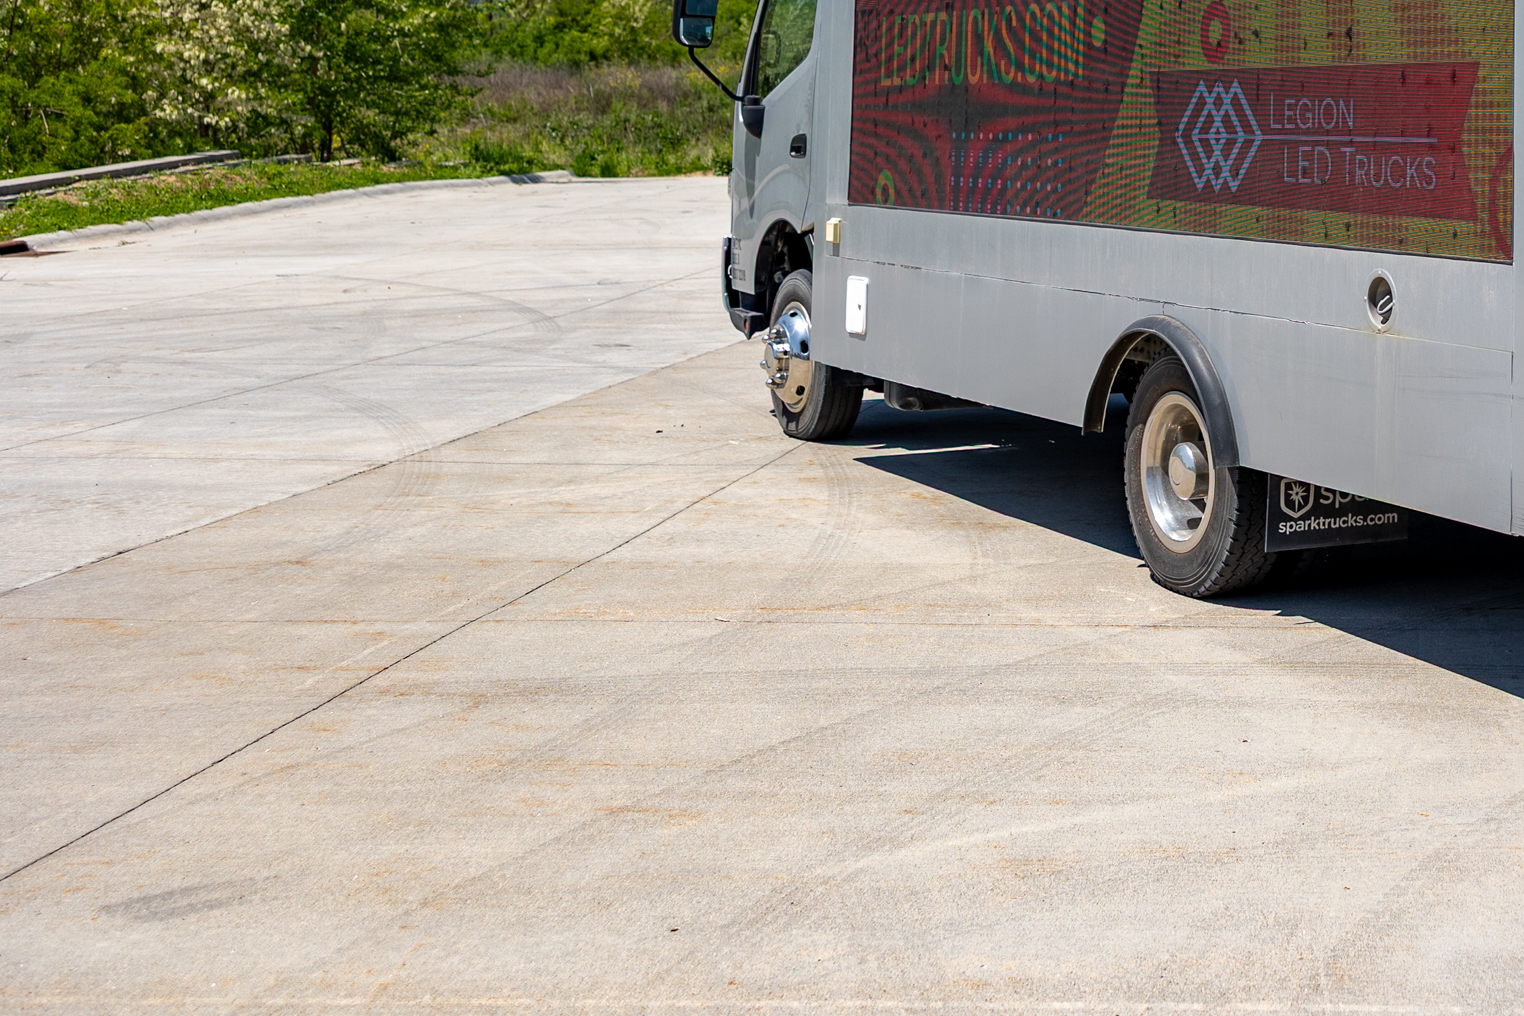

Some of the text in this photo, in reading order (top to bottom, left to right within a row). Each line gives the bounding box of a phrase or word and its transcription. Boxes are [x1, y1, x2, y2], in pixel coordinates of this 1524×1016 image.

[880, 0, 1085, 86] LEDTRUCKS.COM
[1269, 92, 1355, 130] LEGION
[1283, 146, 1437, 190] LED TRUCKS
[1278, 512, 1398, 535] sparktrucks.com
